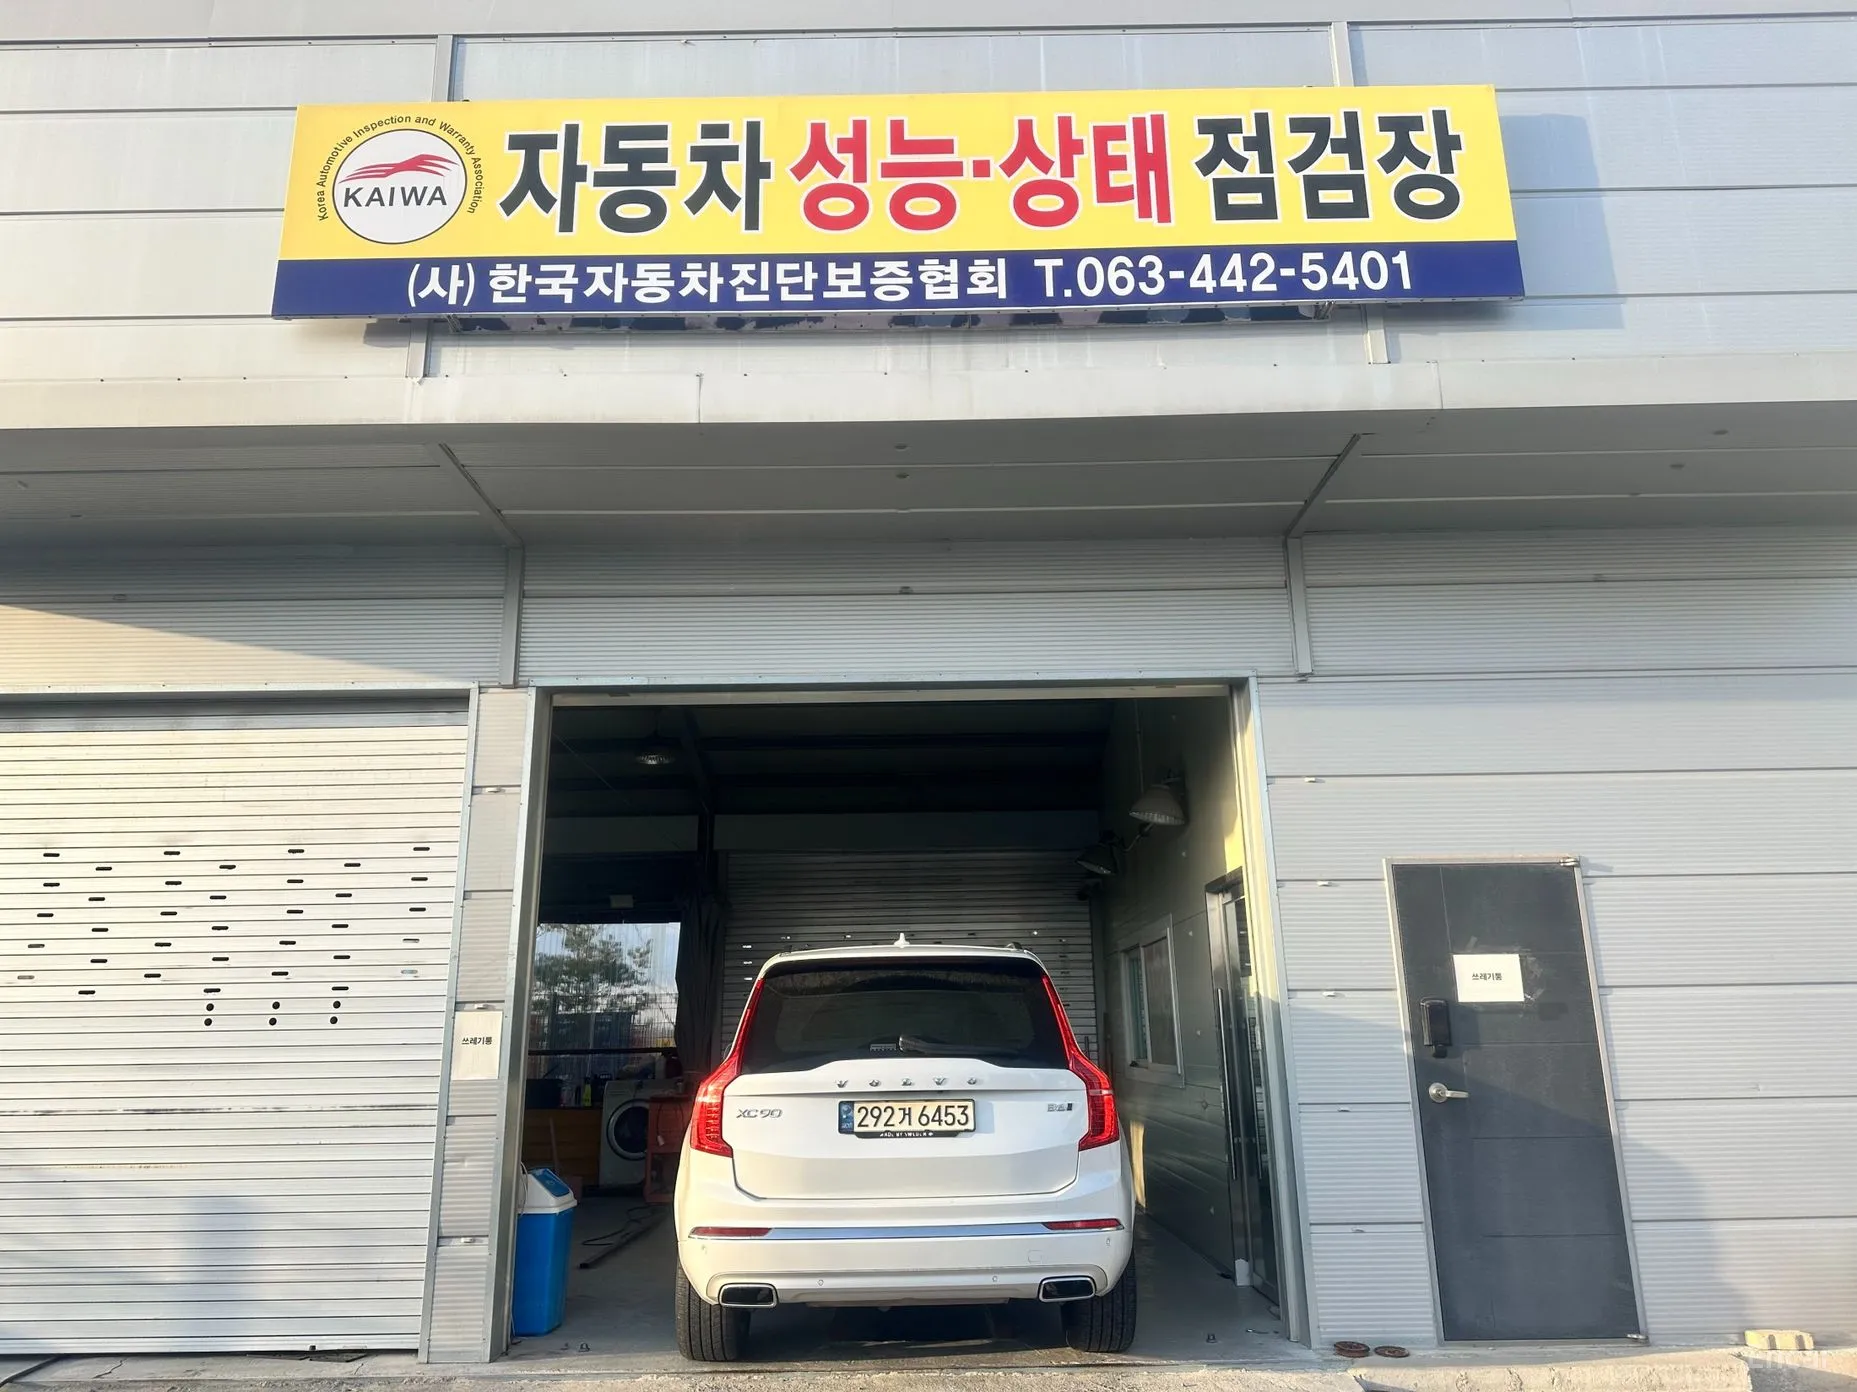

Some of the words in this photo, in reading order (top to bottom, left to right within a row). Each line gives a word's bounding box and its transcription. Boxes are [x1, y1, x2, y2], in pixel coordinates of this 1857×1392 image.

[353, 115, 411, 139] Inspection
[415, 116, 437, 127] and
[439, 121, 476, 156] Warranty
[316, 136, 353, 188] Automotive
[499, 120, 771, 233] 자동차
[1195, 109, 1463, 221] 점검장
[343, 186, 448, 208] KAIWA
[467, 156, 485, 215] Association
[316, 191, 329, 221] Korea
[408, 262, 475, 307] (사)
[489, 258, 1007, 304] 한국자동차진단보증협회
[1034, 250, 1412, 298] T.063-442-5401
[461, 1036, 493, 1046] 쓰레기통
[857, 1105, 912, 1128] 292거
[917, 1105, 969, 1127] 6453
